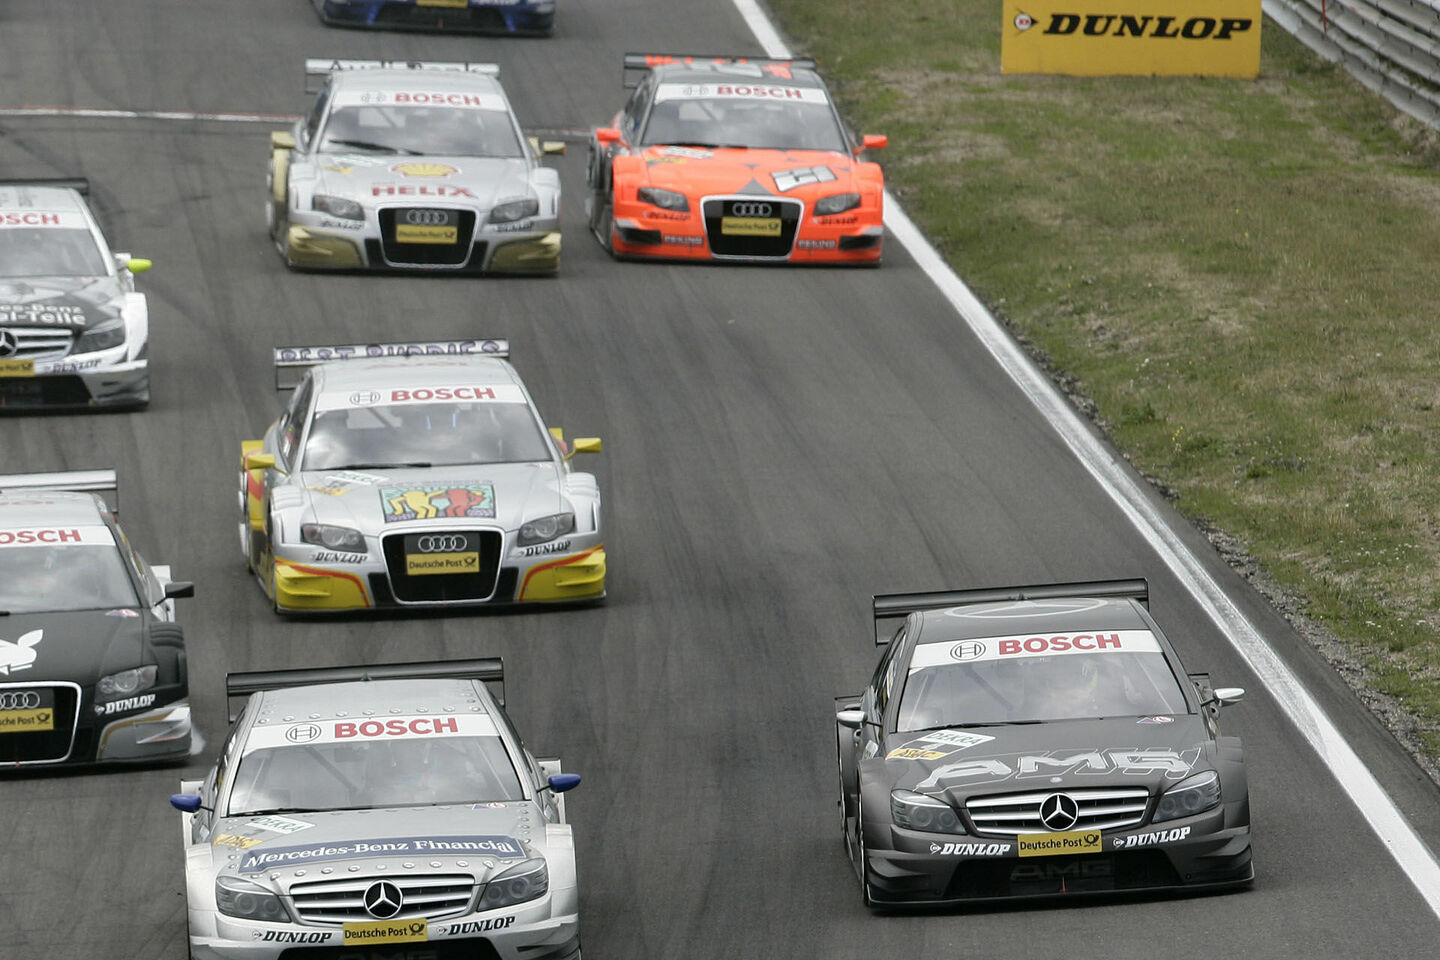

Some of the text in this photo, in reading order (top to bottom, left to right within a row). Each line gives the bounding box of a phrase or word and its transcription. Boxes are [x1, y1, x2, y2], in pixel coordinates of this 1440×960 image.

[1042, 13, 1253, 40] DUNLOP
[395, 92, 481, 106] BOSCH
[716, 85, 803, 99] BOSCH
[371, 184, 474, 198] HELIX
[390, 387, 496, 402] BOSCH
[525, 541, 572, 557] DUNLOP
[315, 551, 368, 564] DUNLOP
[409, 558, 463, 570] Deutsche Post
[998, 633, 1122, 655] BOSCH
[105, 693, 156, 715] DUNLOP
[17, 715, 35, 726] Post
[333, 716, 459, 739] BOSCH
[928, 731, 984, 747] DEKRA
[256, 815, 307, 833] DEKRA
[1020, 837, 1083, 851] Deutsche Post
[1125, 826, 1192, 848] DUNLOP
[243, 838, 518, 869] Mercedes-Benz Financial
[940, 843, 1011, 856] DUNLOP
[345, 925, 408, 940] Deutsche Post
[447, 916, 516, 937] DUNLOP
[262, 930, 333, 944] DUNLOP
